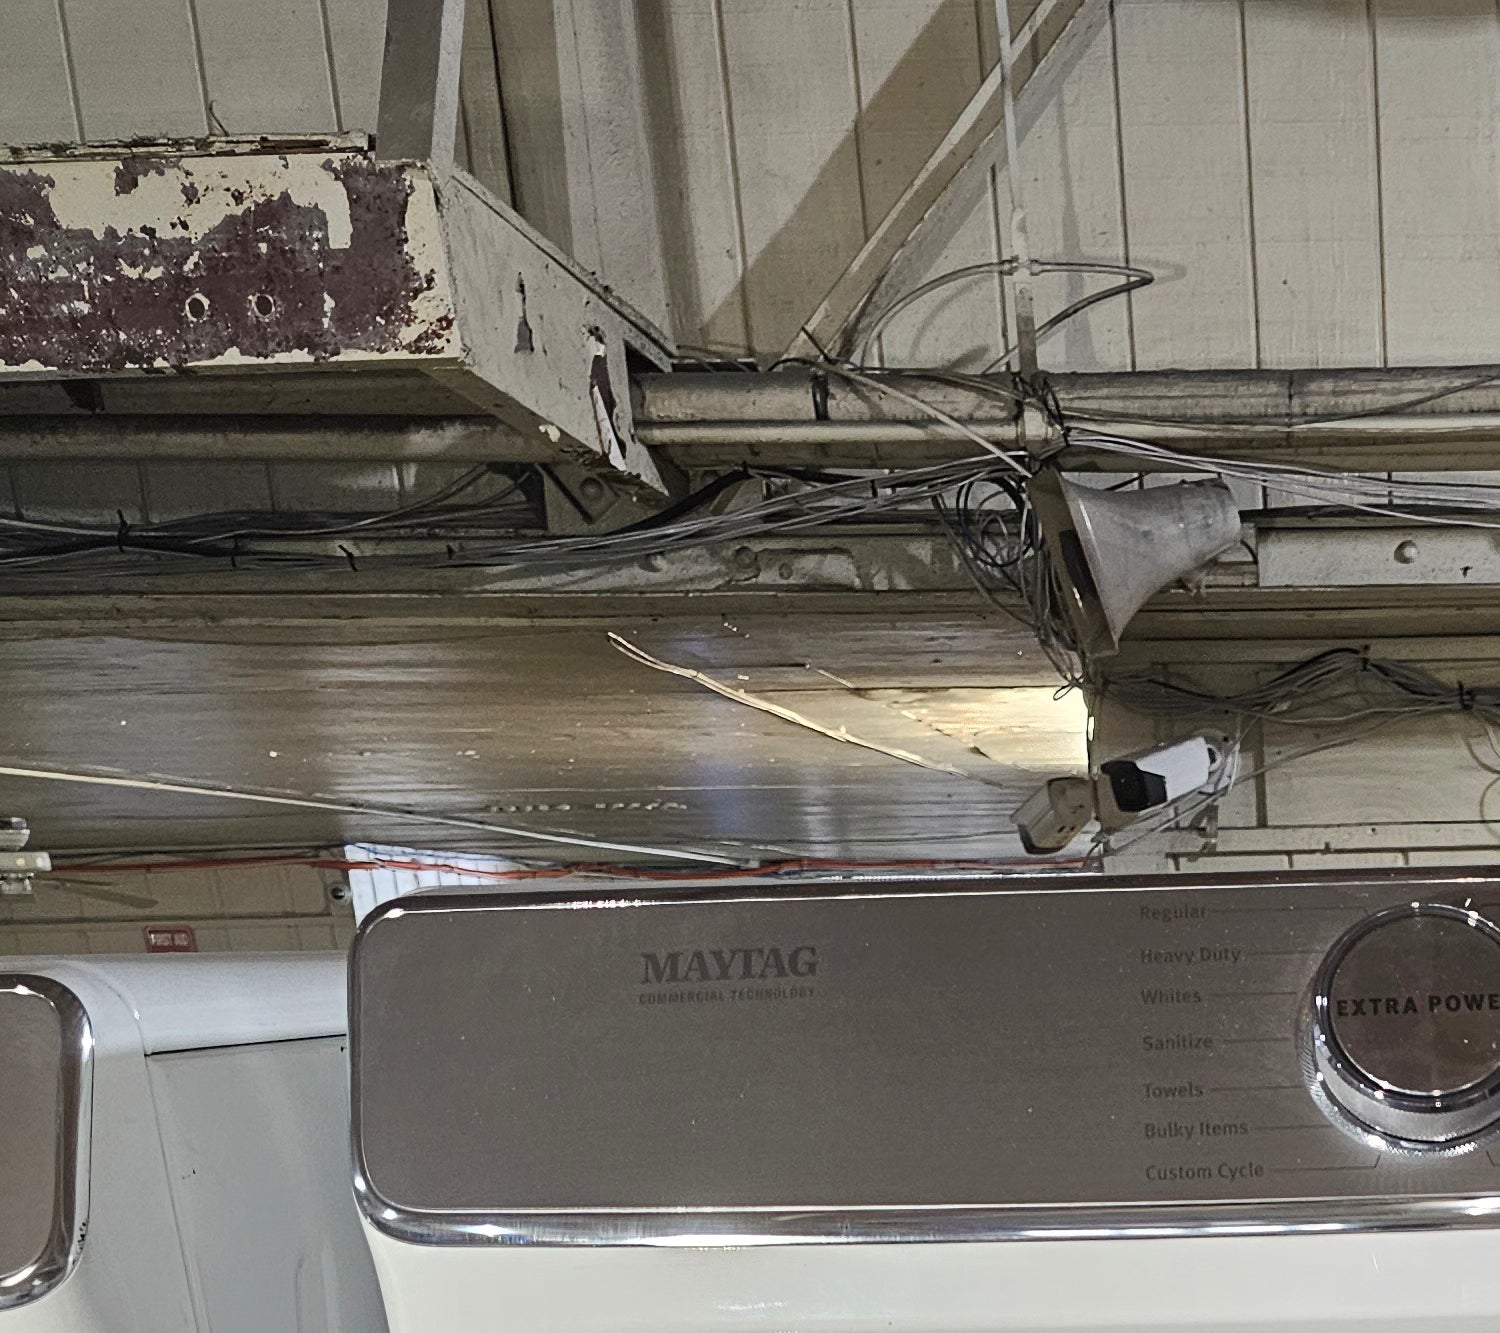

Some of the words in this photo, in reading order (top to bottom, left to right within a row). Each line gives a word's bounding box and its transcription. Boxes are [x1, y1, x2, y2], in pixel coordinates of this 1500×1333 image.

[1140, 904, 1208, 923] Regular
[640, 946, 818, 984] MAYTAG
[1141, 949, 1195, 966] Heavy
[1200, 947, 1241, 963] Duty
[1141, 988, 1203, 1005] Whites
[1336, 996, 1418, 1017] EXTRA
[1142, 1033, 1214, 1051] Sanitize
[1143, 1081, 1205, 1099] Towels
[1144, 1121, 1195, 1140] Bulky
[1200, 1121, 1249, 1137] Items
[1145, 1163, 1212, 1181] Custom
[1217, 1161, 1264, 1182] Cycle
